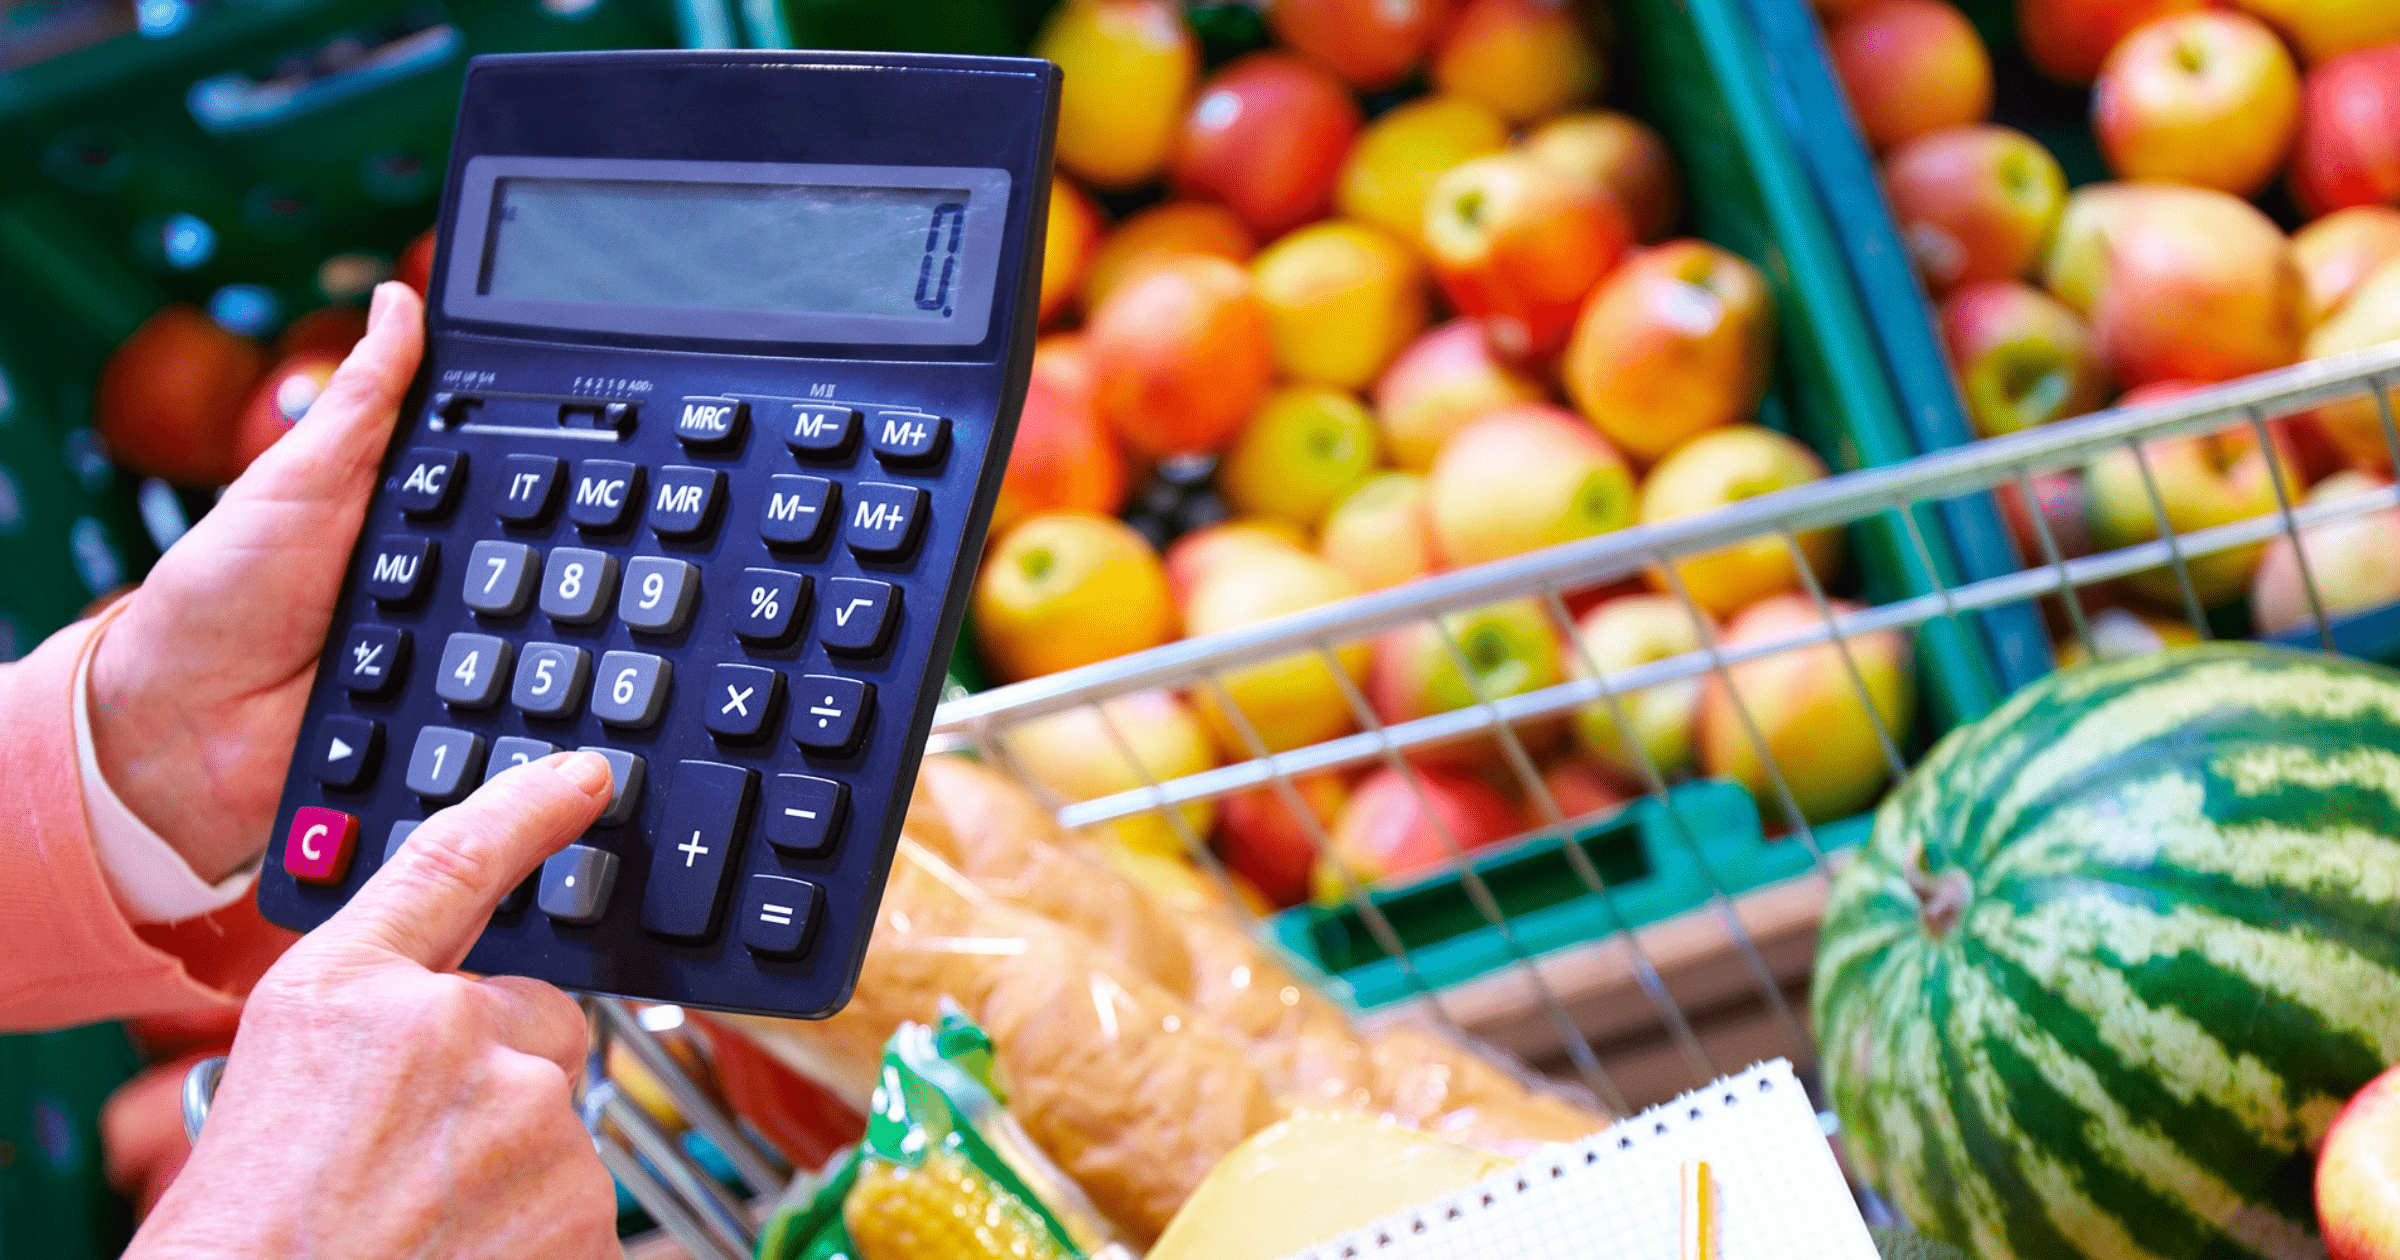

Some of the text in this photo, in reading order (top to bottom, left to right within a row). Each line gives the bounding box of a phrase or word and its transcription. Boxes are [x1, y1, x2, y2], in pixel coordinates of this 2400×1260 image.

[595, 377, 604, 389] 2
[608, 379, 614, 389] 1
[681, 406, 731, 431] MRC
[882, 421, 928, 446] M+
[403, 464, 446, 493] AC
[510, 474, 539, 500] IT
[577, 478, 623, 507] MC
[657, 484, 702, 513] MR
[854, 501, 903, 530] M+
[374, 554, 417, 582] MU
[484, 558, 506, 592] 7
[560, 564, 583, 598] 8
[640, 573, 663, 608] 9
[751, 587, 778, 619] %
[455, 651, 478, 685] 4
[532, 660, 556, 694] 5
[613, 669, 637, 704] 6
[432, 745, 446, 779] 1
[302, 824, 327, 860] C
